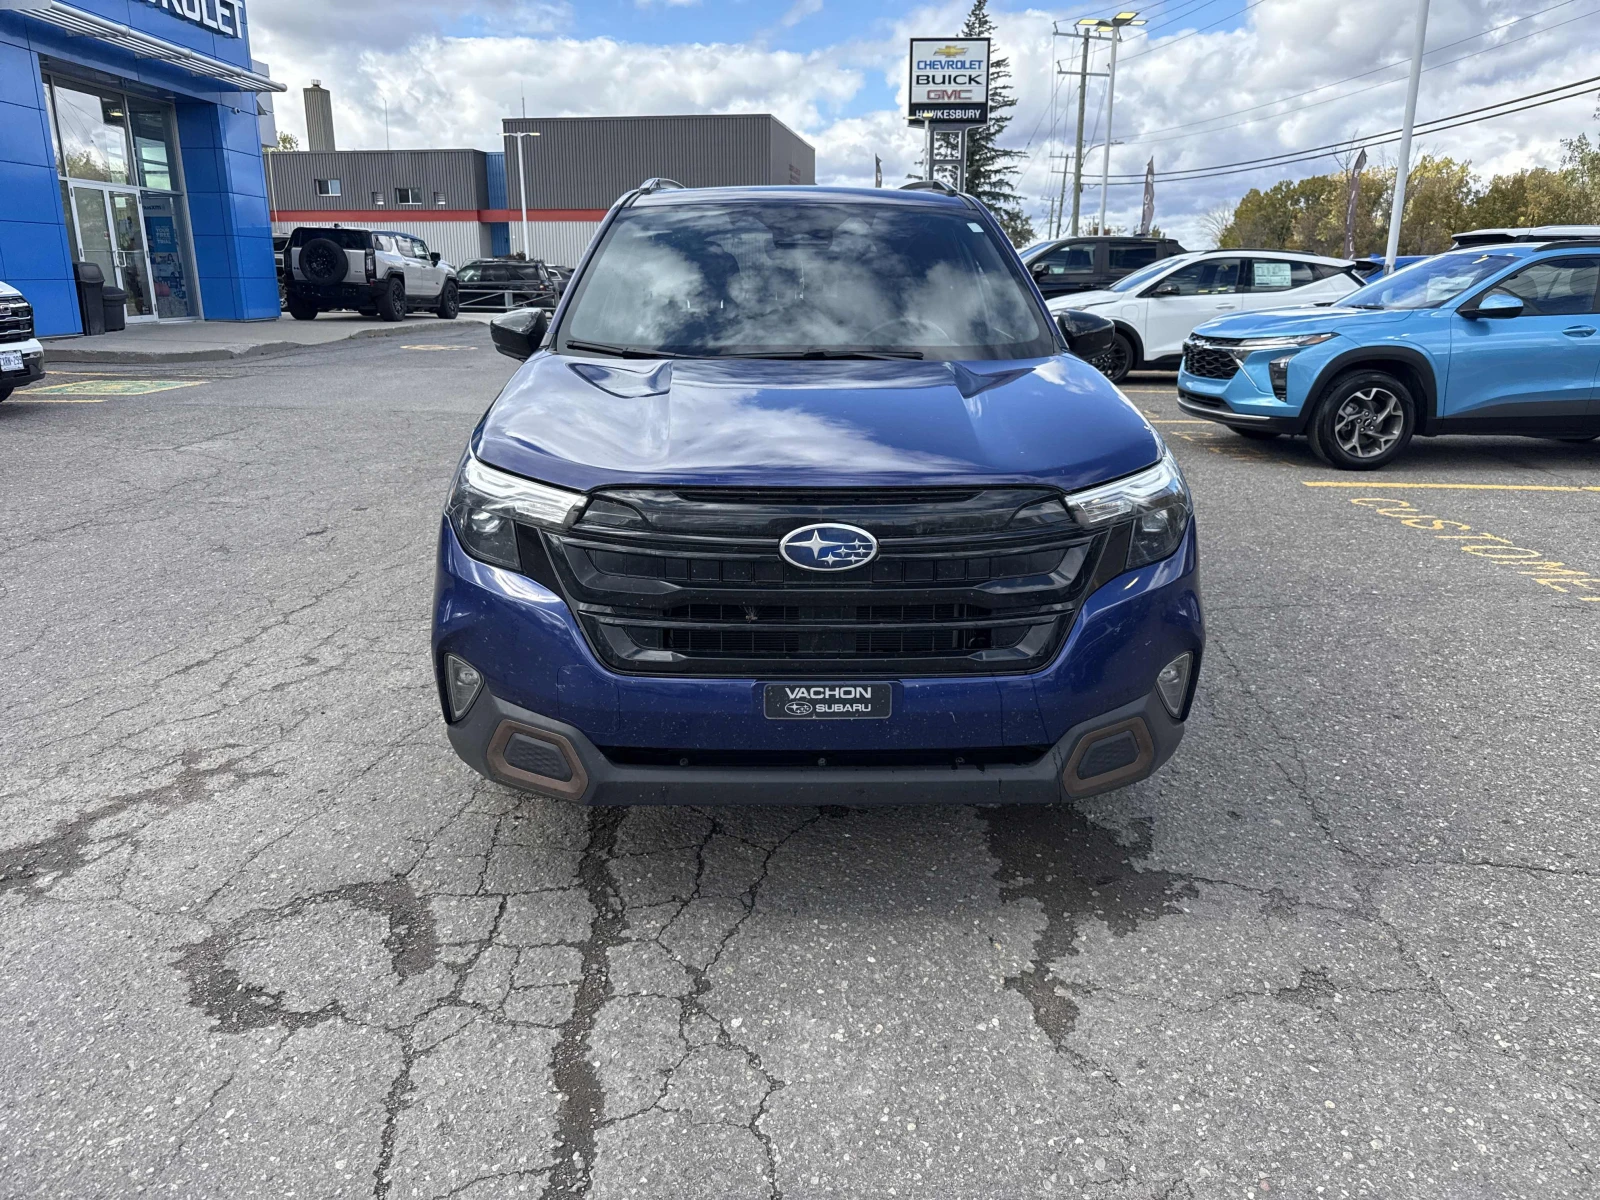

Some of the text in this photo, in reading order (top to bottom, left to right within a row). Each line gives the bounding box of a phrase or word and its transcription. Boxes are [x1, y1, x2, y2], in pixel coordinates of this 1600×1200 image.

[917, 60, 983, 70] CHEVROLET
[916, 74, 982, 85] BUICK
[927, 89, 972, 100] GMC
[785, 687, 872, 699] VACHON
[815, 703, 872, 712] SUBARU
